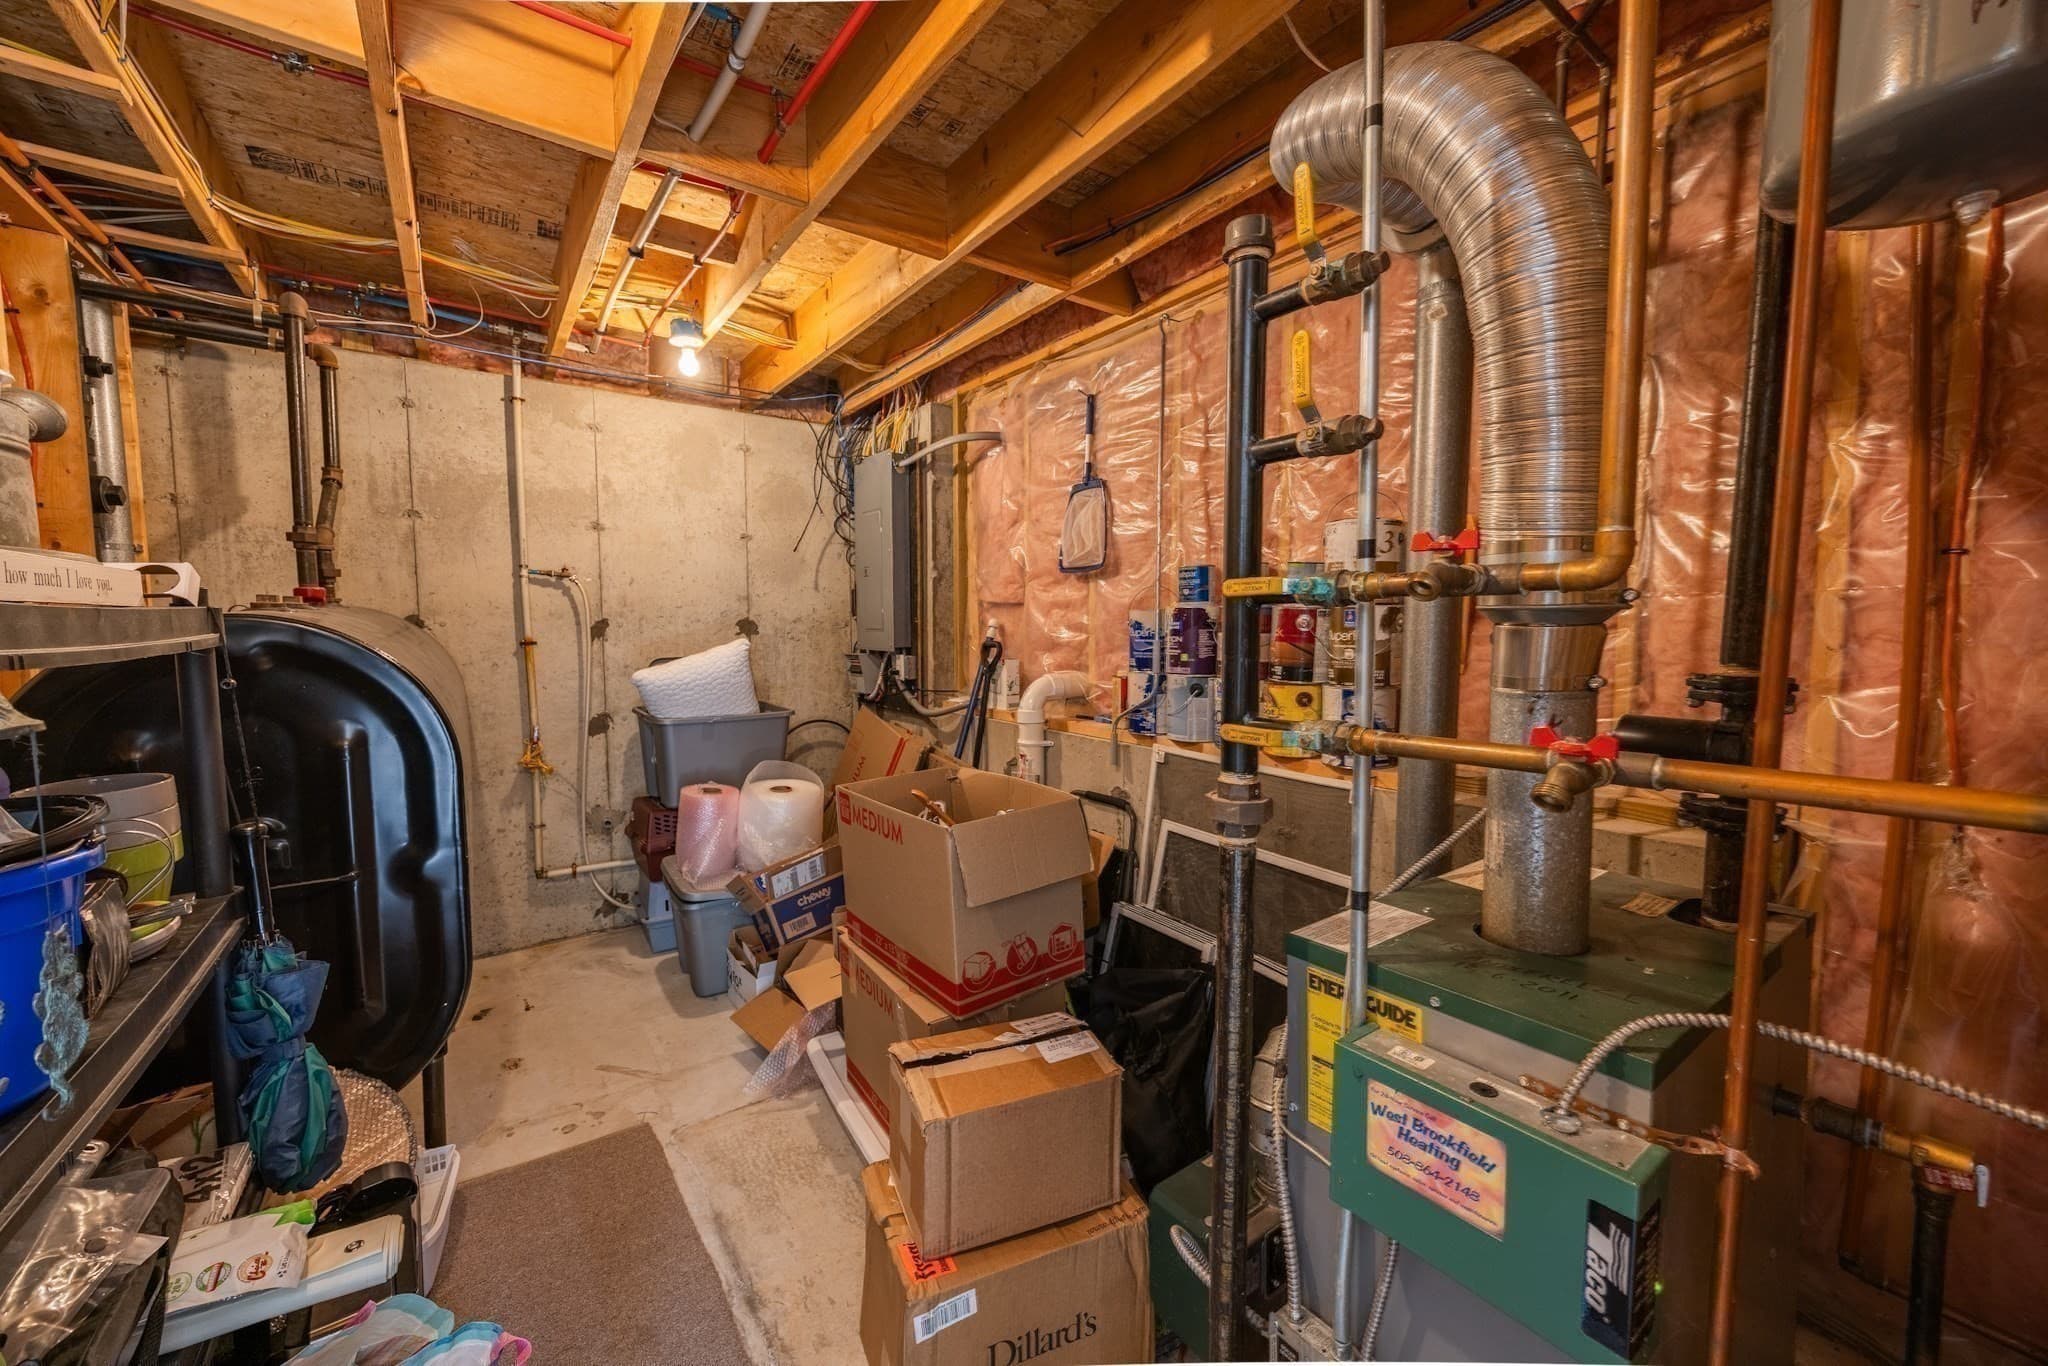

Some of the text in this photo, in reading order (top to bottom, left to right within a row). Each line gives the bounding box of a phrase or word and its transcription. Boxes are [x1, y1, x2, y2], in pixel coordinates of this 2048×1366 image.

[3, 561, 113, 597] how much I love you.
[851, 806, 904, 846] MEDIUM
[797, 886, 832, 907] chewy
[1308, 973, 1345, 1000] ENER
[1366, 996, 1417, 1031] GUIDE
[1370, 1102, 1497, 1174] West Brookfield
[1397, 1126, 1461, 1172] Heating
[1585, 1221, 1631, 1315] Taco
[987, 1312, 1097, 1364] Dillard's
